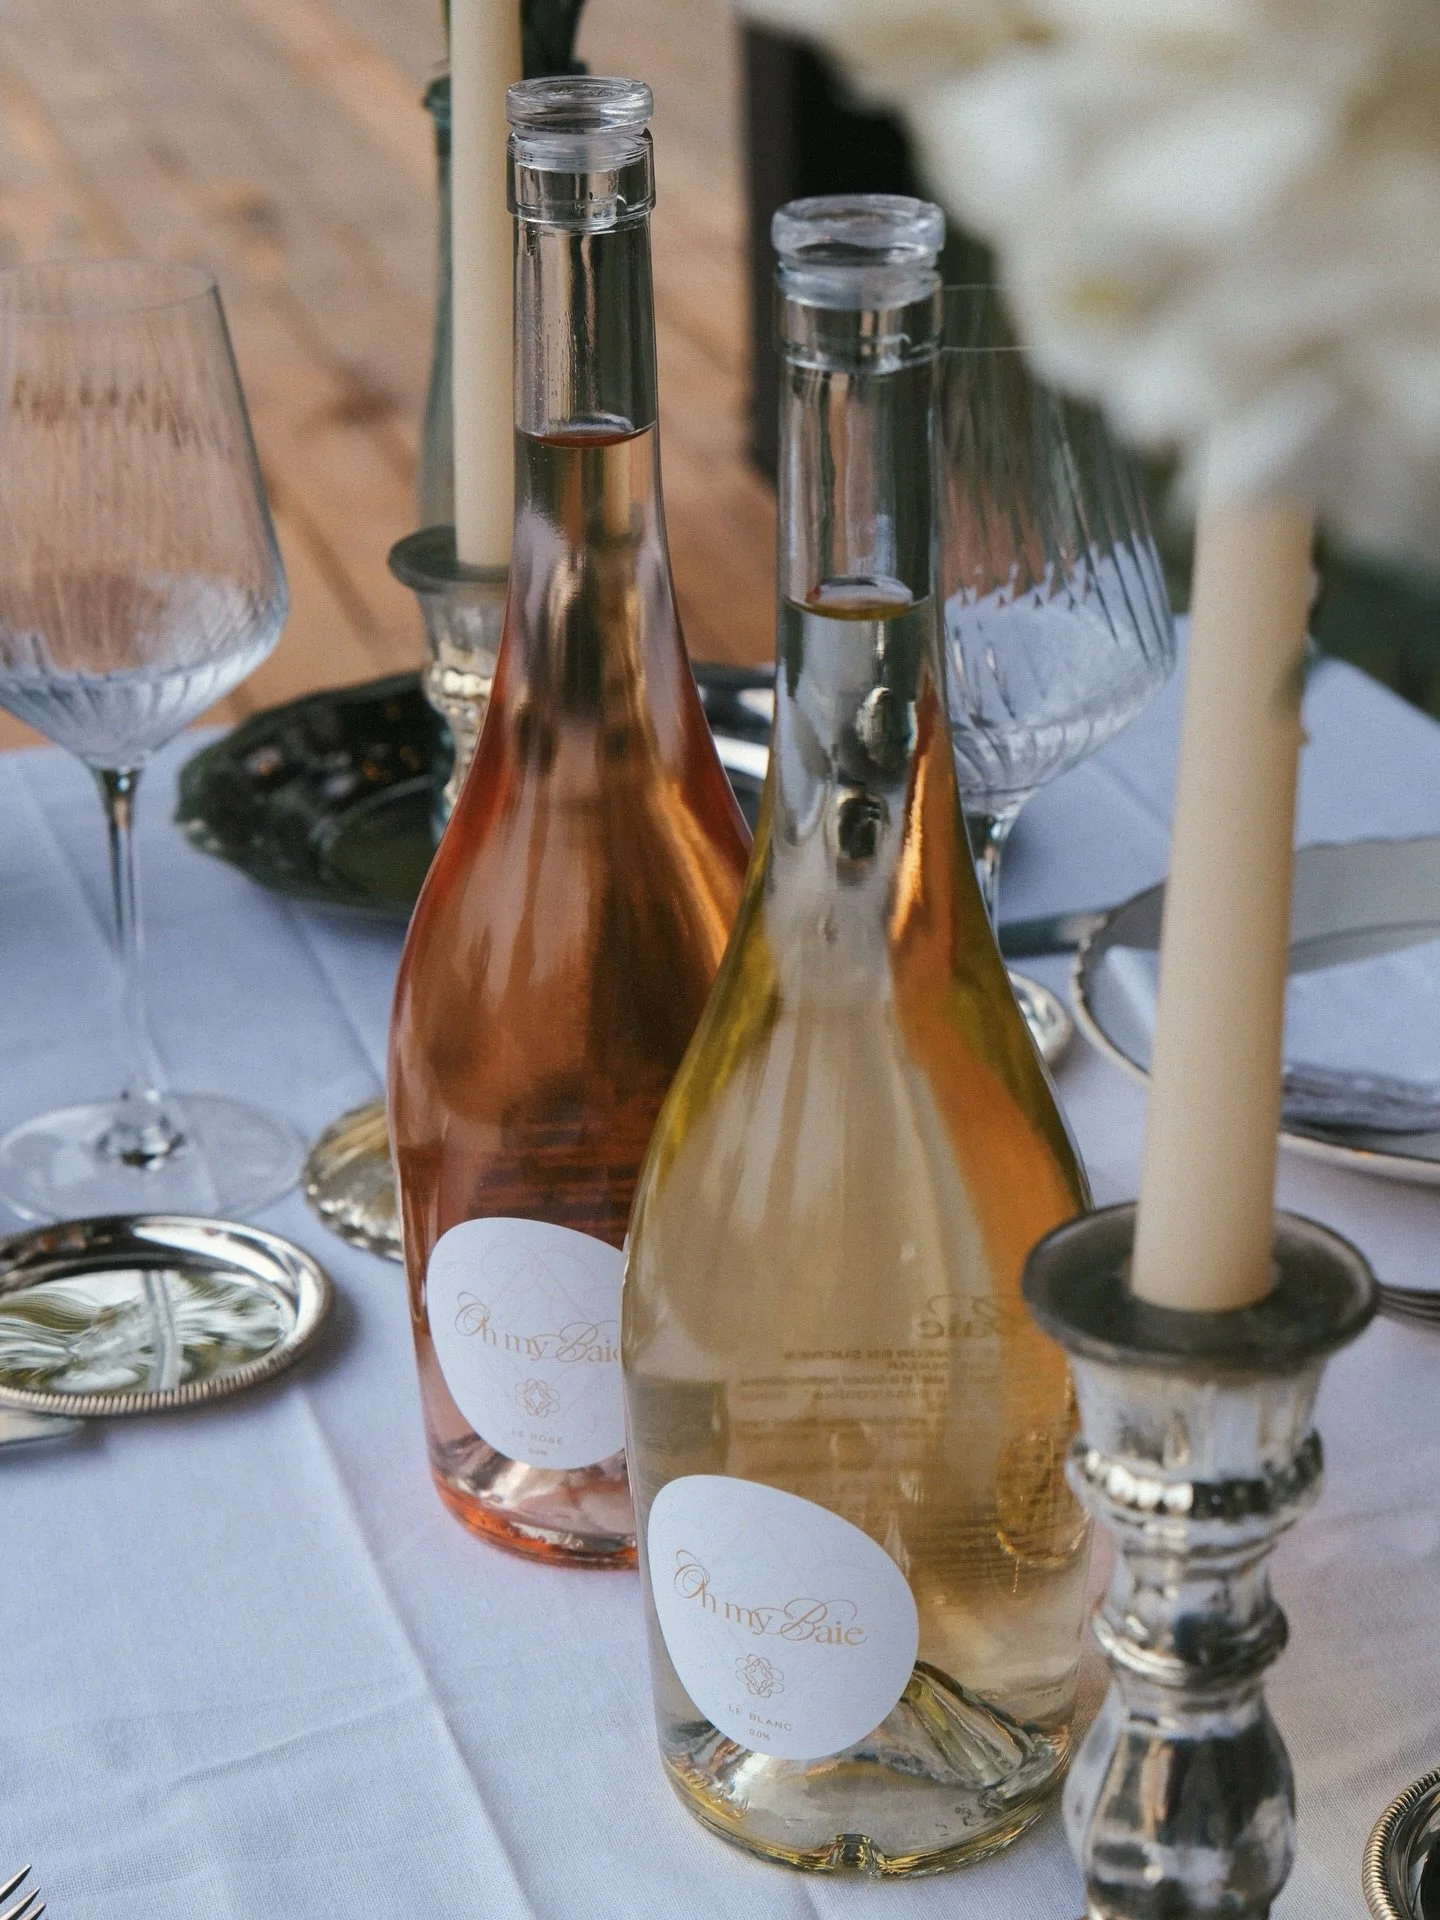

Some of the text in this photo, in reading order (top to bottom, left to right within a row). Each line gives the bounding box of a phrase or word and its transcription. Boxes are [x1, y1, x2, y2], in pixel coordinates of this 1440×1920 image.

[454, 1291, 497, 1346] Oh
[504, 1332, 548, 1361] my
[673, 1549, 868, 1646] Oh my Baie
[728, 1704, 793, 1731] LE BLANC
[748, 1728, 771, 1742] 0.0%
